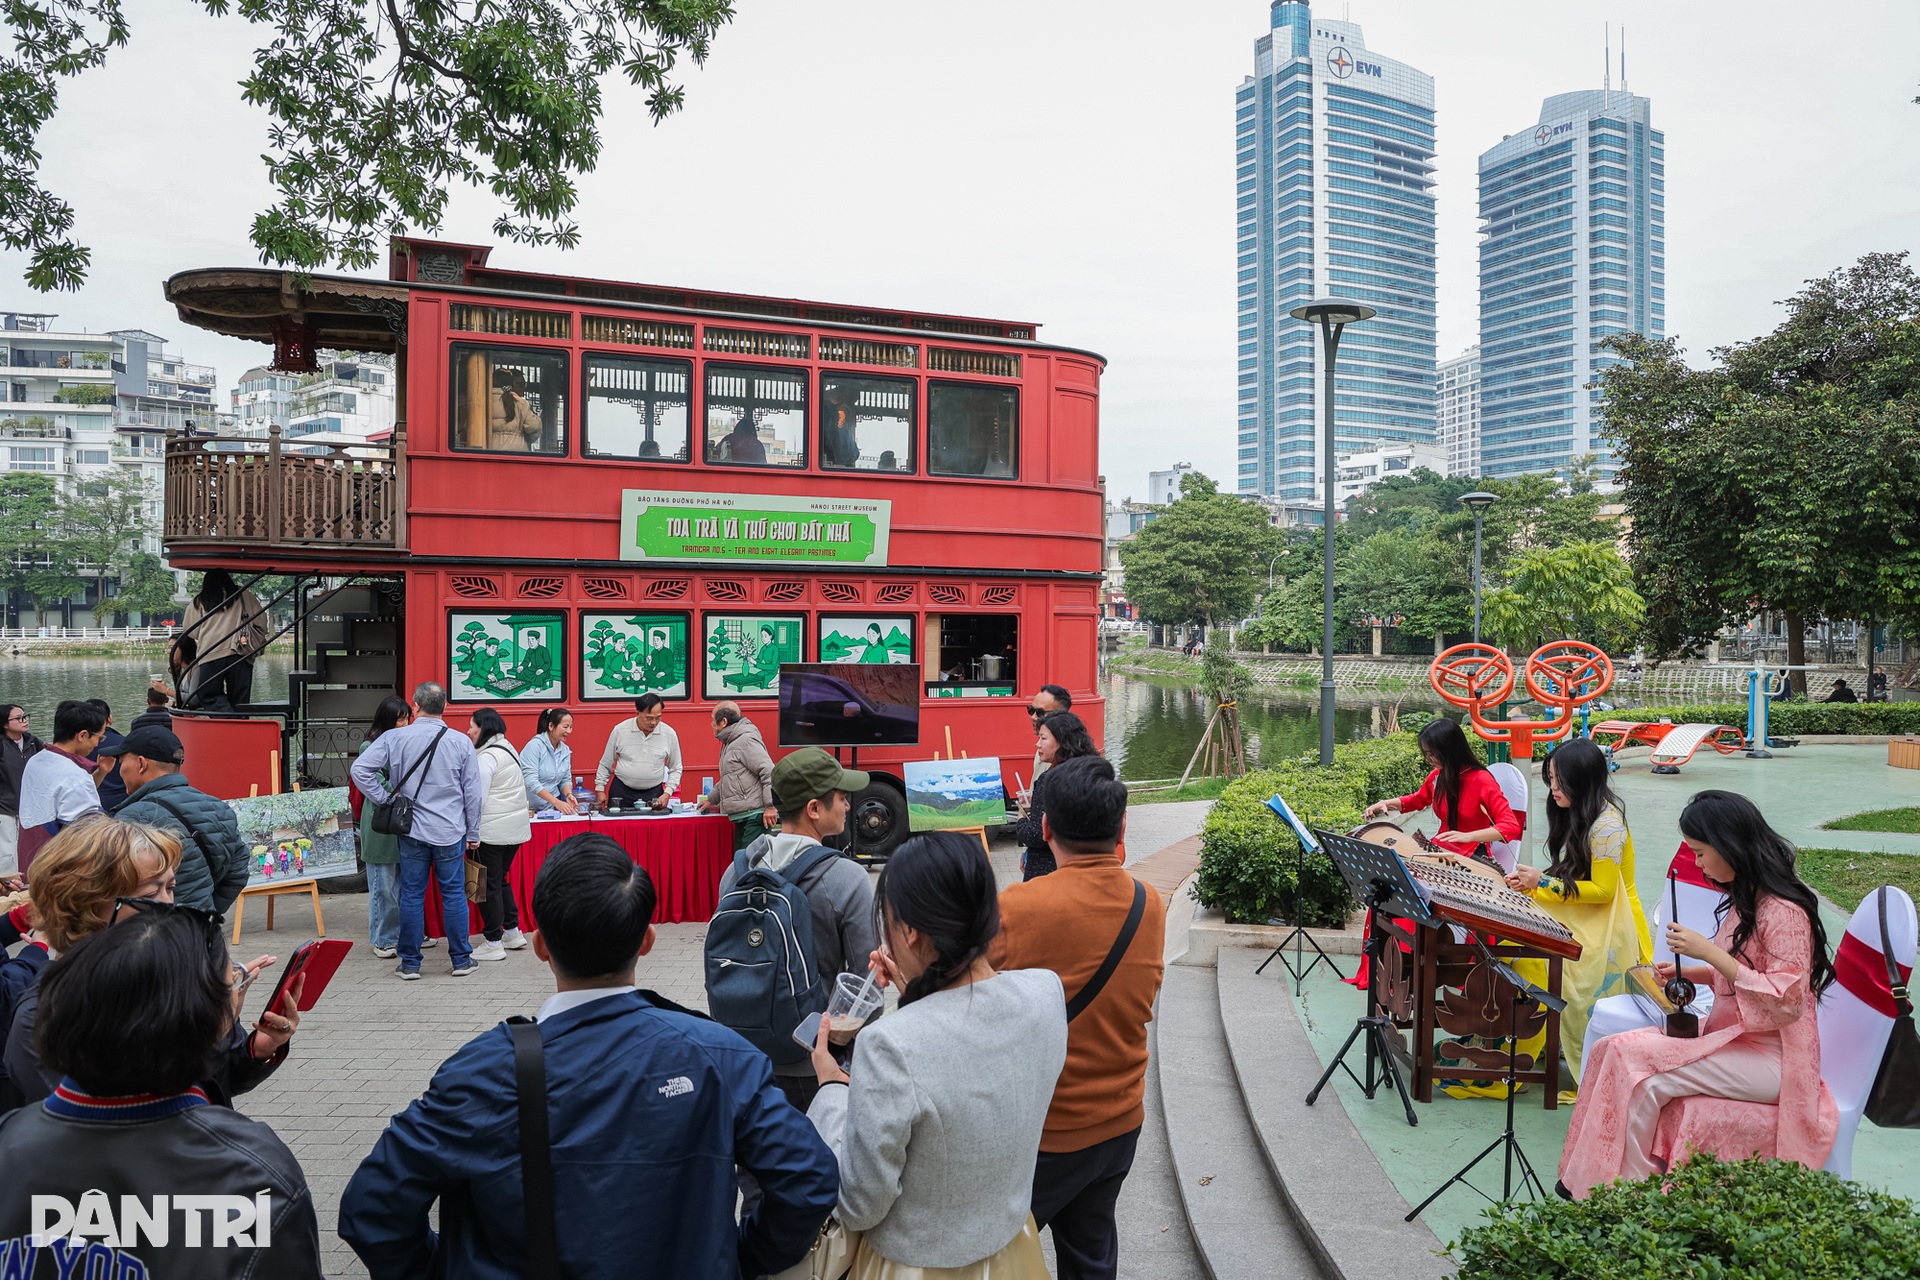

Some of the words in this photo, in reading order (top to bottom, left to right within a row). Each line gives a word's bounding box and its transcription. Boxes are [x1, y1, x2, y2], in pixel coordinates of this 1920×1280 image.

[1356, 60, 1381, 78] EVN
[1553, 121, 1573, 136] EVN
[666, 517, 691, 538] TOA
[695, 515, 720, 539] TRÀ
[723, 516, 740, 540] VÀ
[743, 517, 768, 540] THÚ
[800, 519, 824, 542] BÁT
[681, 545, 711, 553] TRAMCAR
[734, 546, 746, 555] TEA
[748, 547, 760, 555] AND
[761, 547, 778, 556] EIGHT
[780, 548, 805, 556] ELEGANT
[807, 548, 836, 557] PASTIMES
[667, 1076, 681, 1086] THE
[658, 1083, 683, 1095] NORTH
[665, 1088, 683, 1099] FACE
